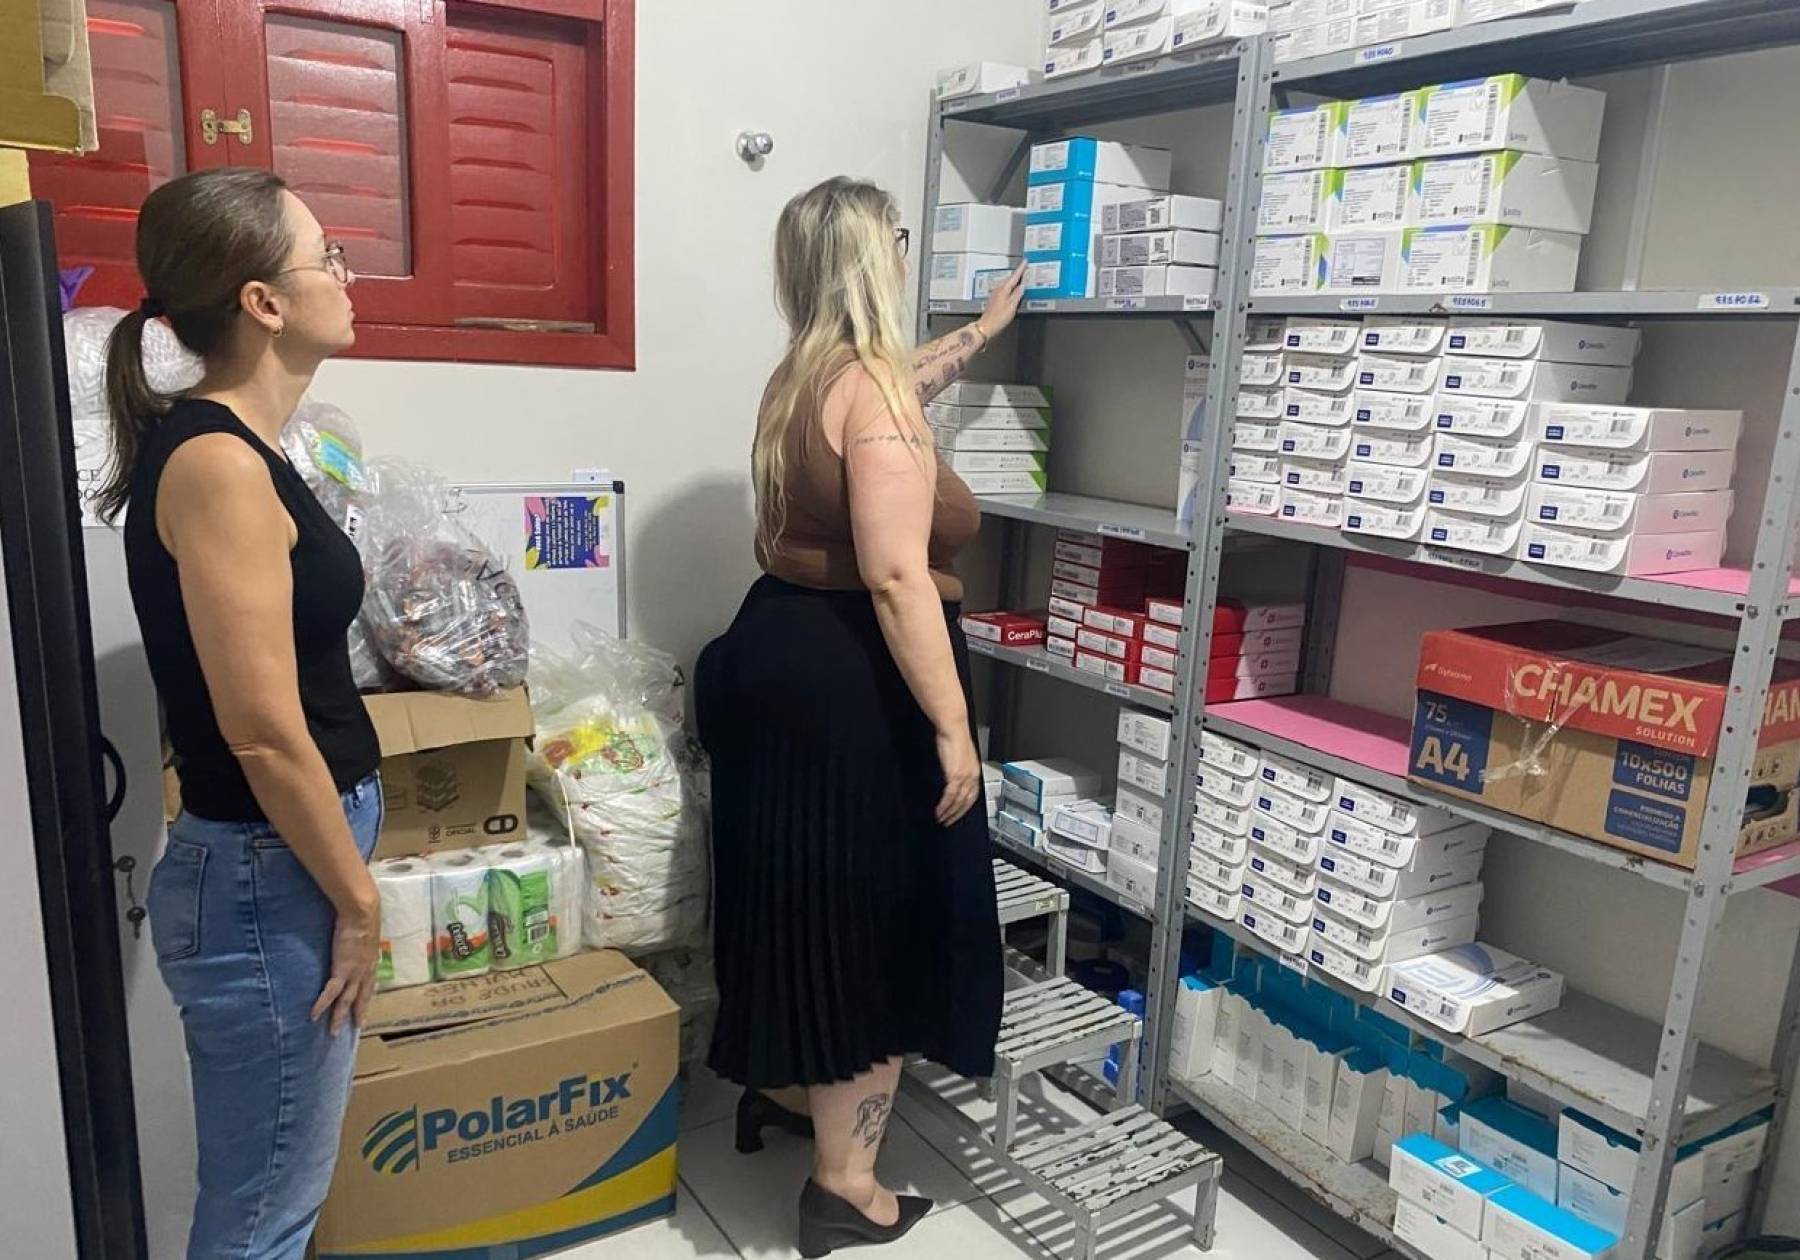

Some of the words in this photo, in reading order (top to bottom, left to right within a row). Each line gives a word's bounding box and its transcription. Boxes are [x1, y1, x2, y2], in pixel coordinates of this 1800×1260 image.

[1425, 701, 1449, 723] 75
[1513, 663, 1704, 732] CHAMEX
[1416, 736, 1470, 782] A4
[1635, 726, 1695, 747] SOLUTION
[1636, 772, 1686, 795] FOLHAS
[422, 1070, 632, 1152] PolarFix
[447, 1131, 544, 1164] ESSENCIAL
[564, 1104, 619, 1133] SAÚDE
